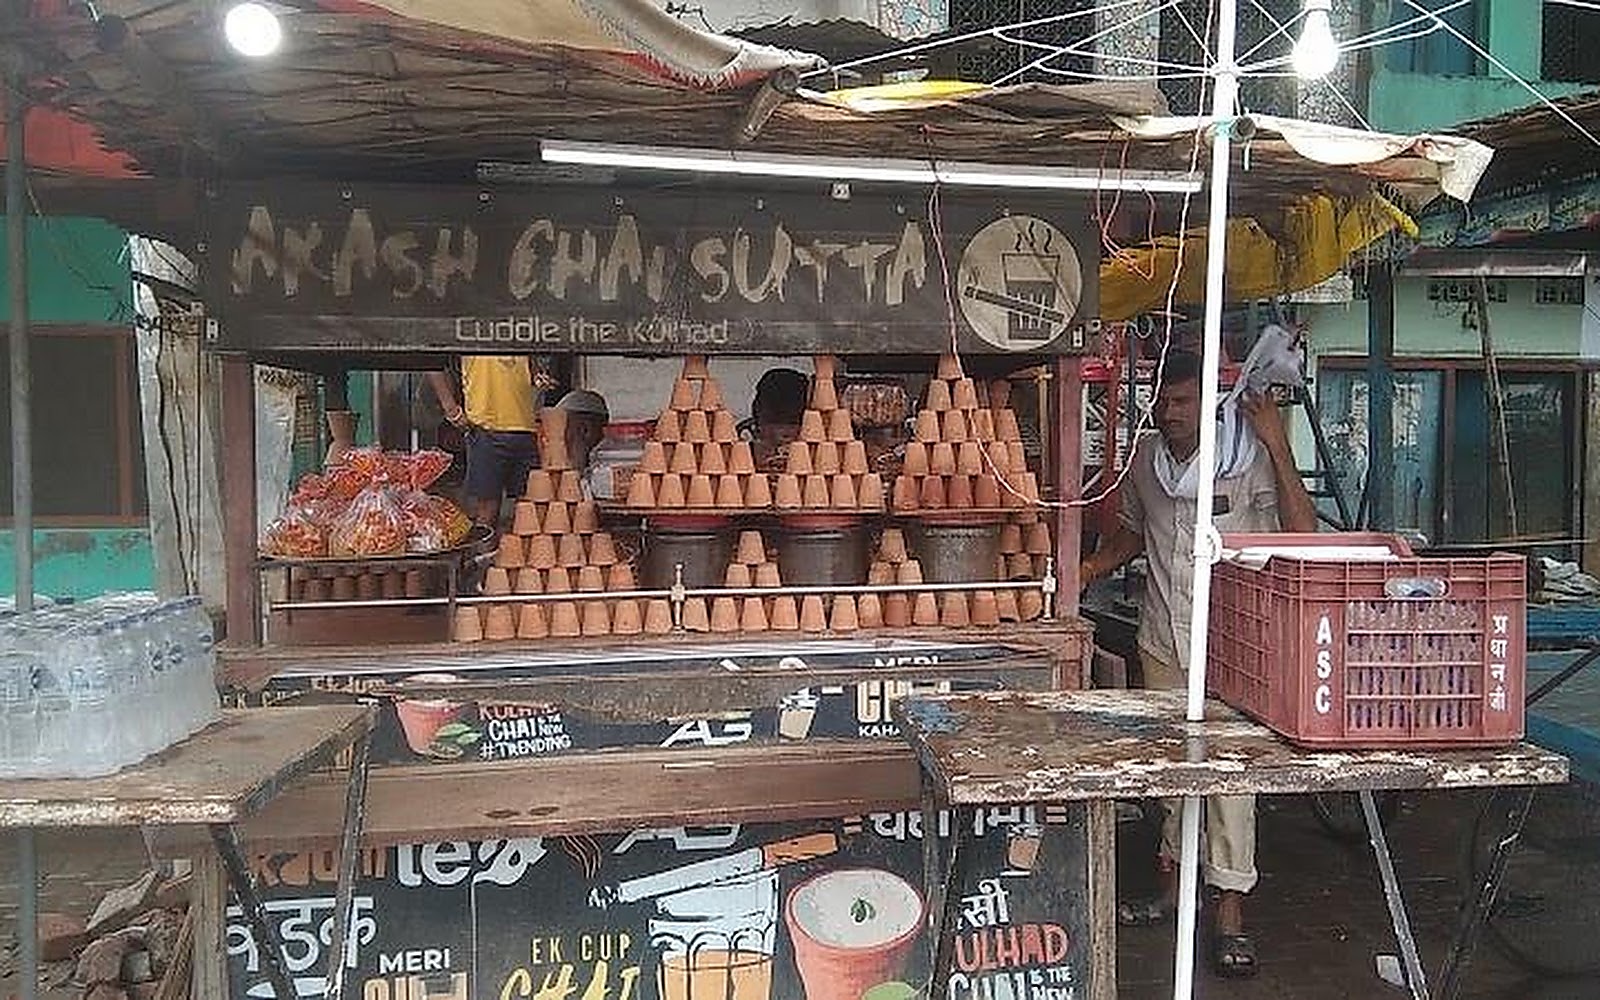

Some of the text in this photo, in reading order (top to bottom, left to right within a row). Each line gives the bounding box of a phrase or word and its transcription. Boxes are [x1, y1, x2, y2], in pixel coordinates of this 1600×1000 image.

[231, 206, 927, 305] AKASH CHAI SUTTA
[455, 317, 561, 342] Cuddle
[569, 317, 617, 343] the
[488, 716, 538, 742] CHAI
[480, 733, 573, 760] #TRENDING
[379, 948, 451, 975] MERI
[531, 932, 632, 965] EK CUP
